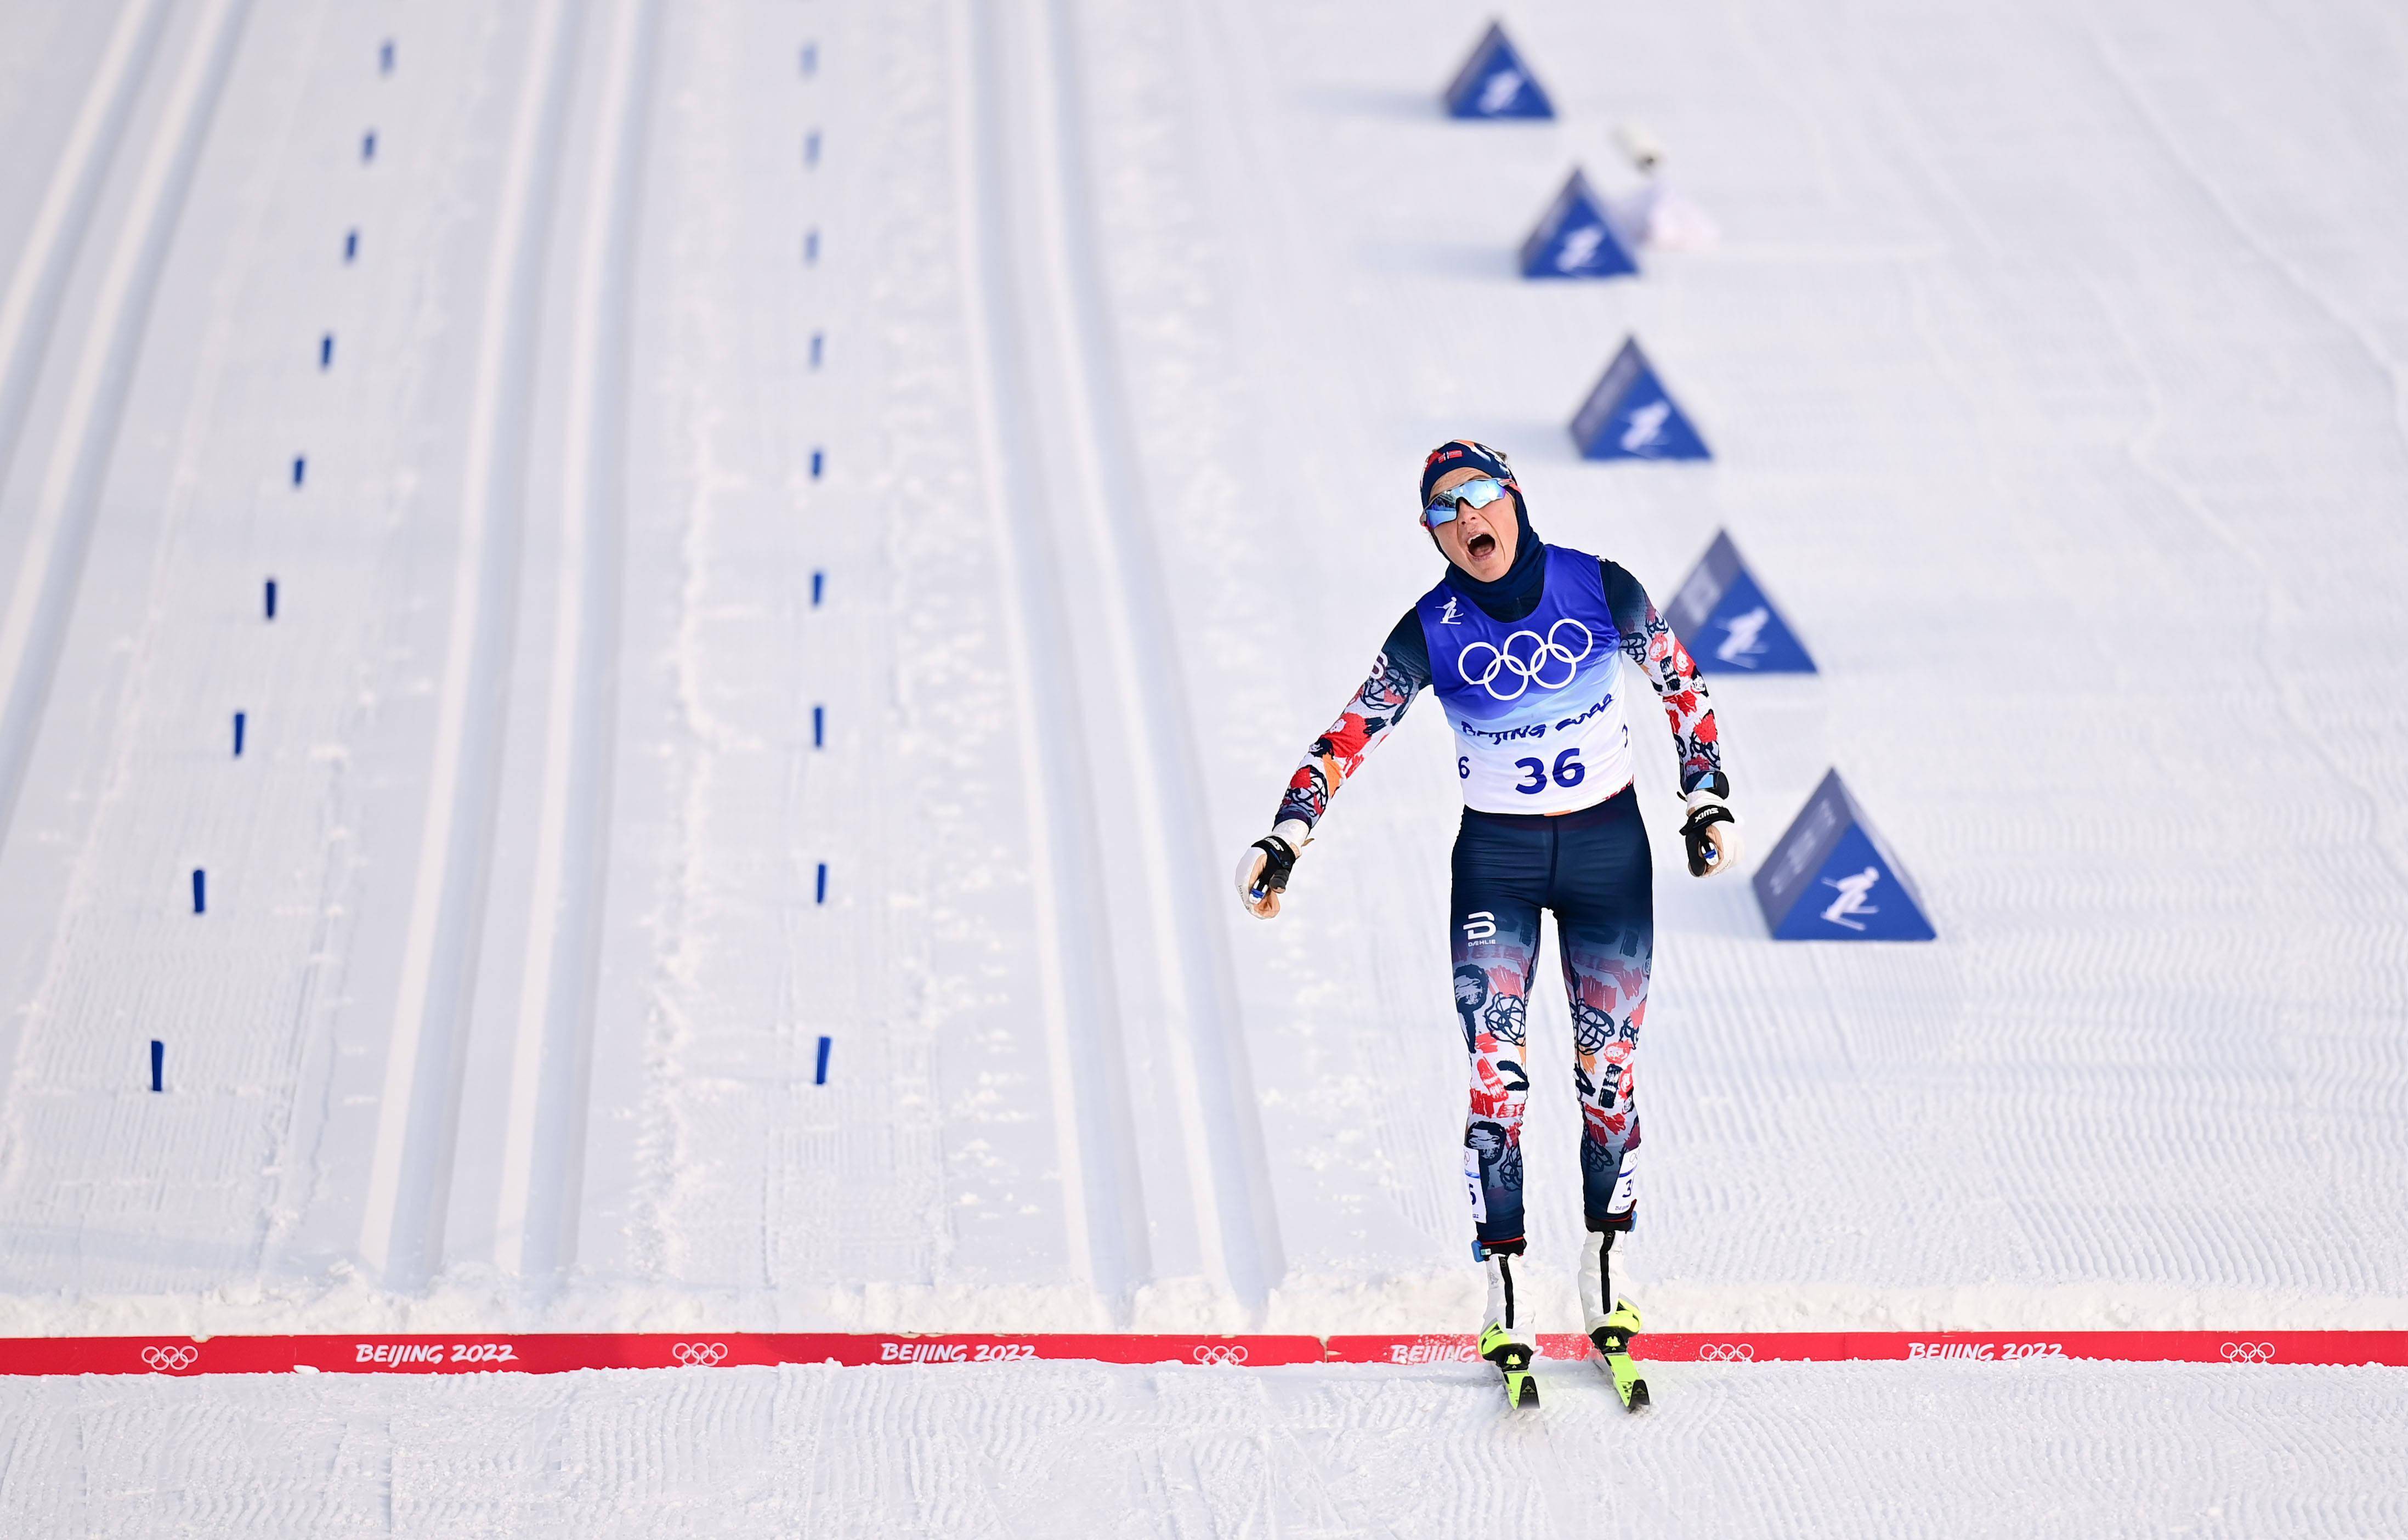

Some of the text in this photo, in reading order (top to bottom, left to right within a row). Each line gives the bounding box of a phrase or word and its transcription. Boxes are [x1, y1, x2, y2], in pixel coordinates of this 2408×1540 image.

[1514, 748, 1585, 795] 36
[1622, 1178, 1633, 1198] 3
[356, 1344, 519, 1368] BEIJING 2022
[881, 1343, 1041, 1363] BEIJING 2022
[1390, 1344, 1477, 1363] BEIJING
[1908, 1342, 2069, 1361] BEIJING 2022
